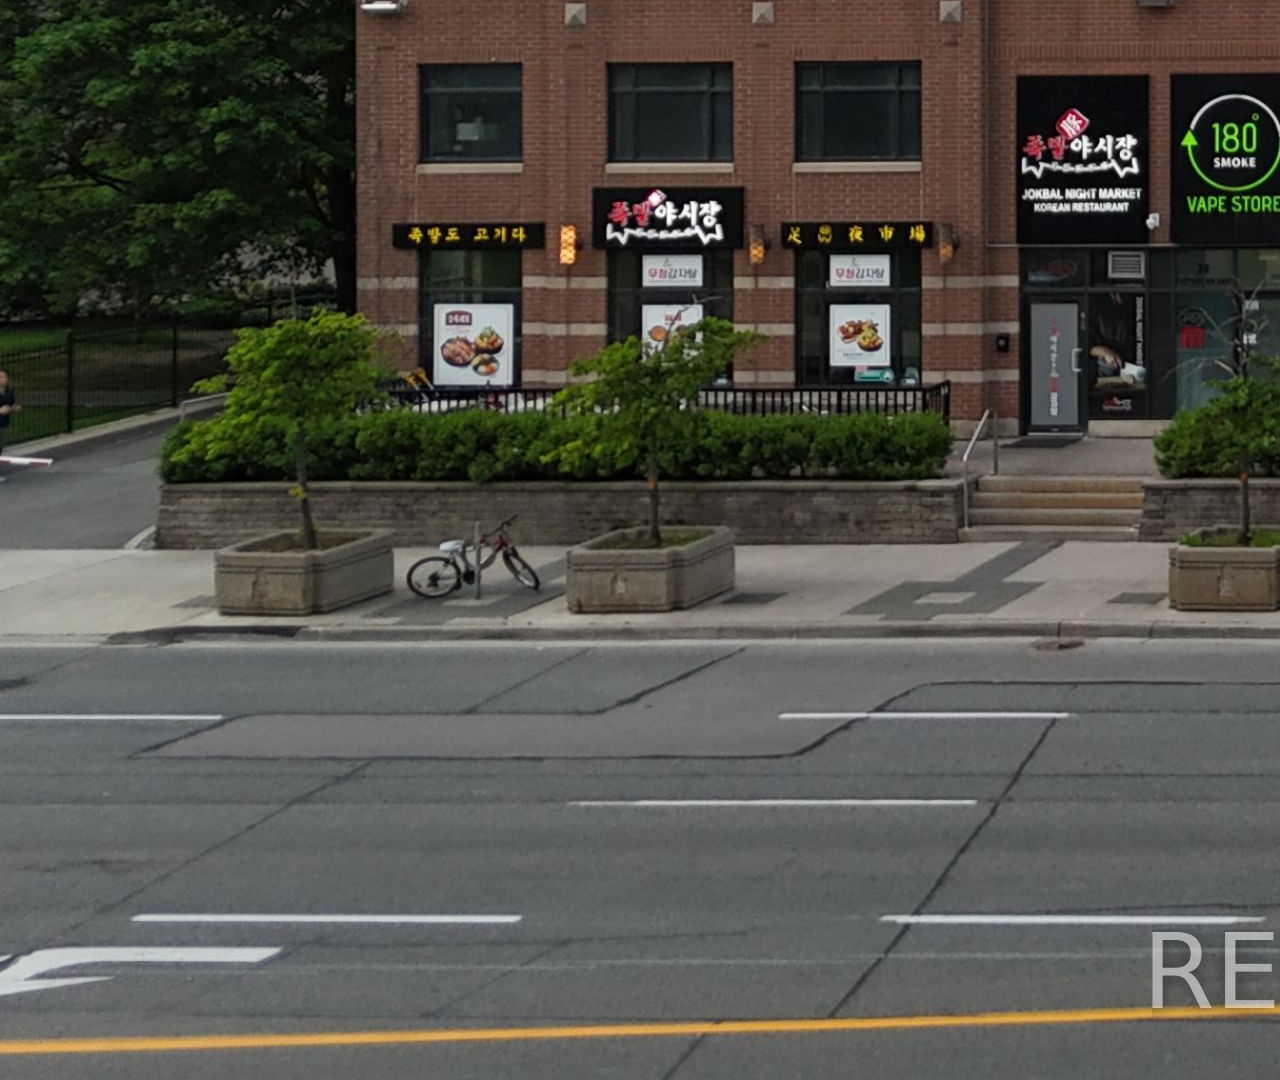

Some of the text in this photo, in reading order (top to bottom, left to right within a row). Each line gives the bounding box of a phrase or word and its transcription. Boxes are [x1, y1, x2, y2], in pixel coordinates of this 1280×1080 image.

[1213, 157, 1256, 168] SMOKE
[1022, 188, 1142, 200] JOKBAL NIGHT MARKET
[1034, 202, 1130, 212] KOREAN RESTAURANT
[1187, 195, 1227, 212] VAPE
[408, 226, 527, 245] 족발도 고기다
